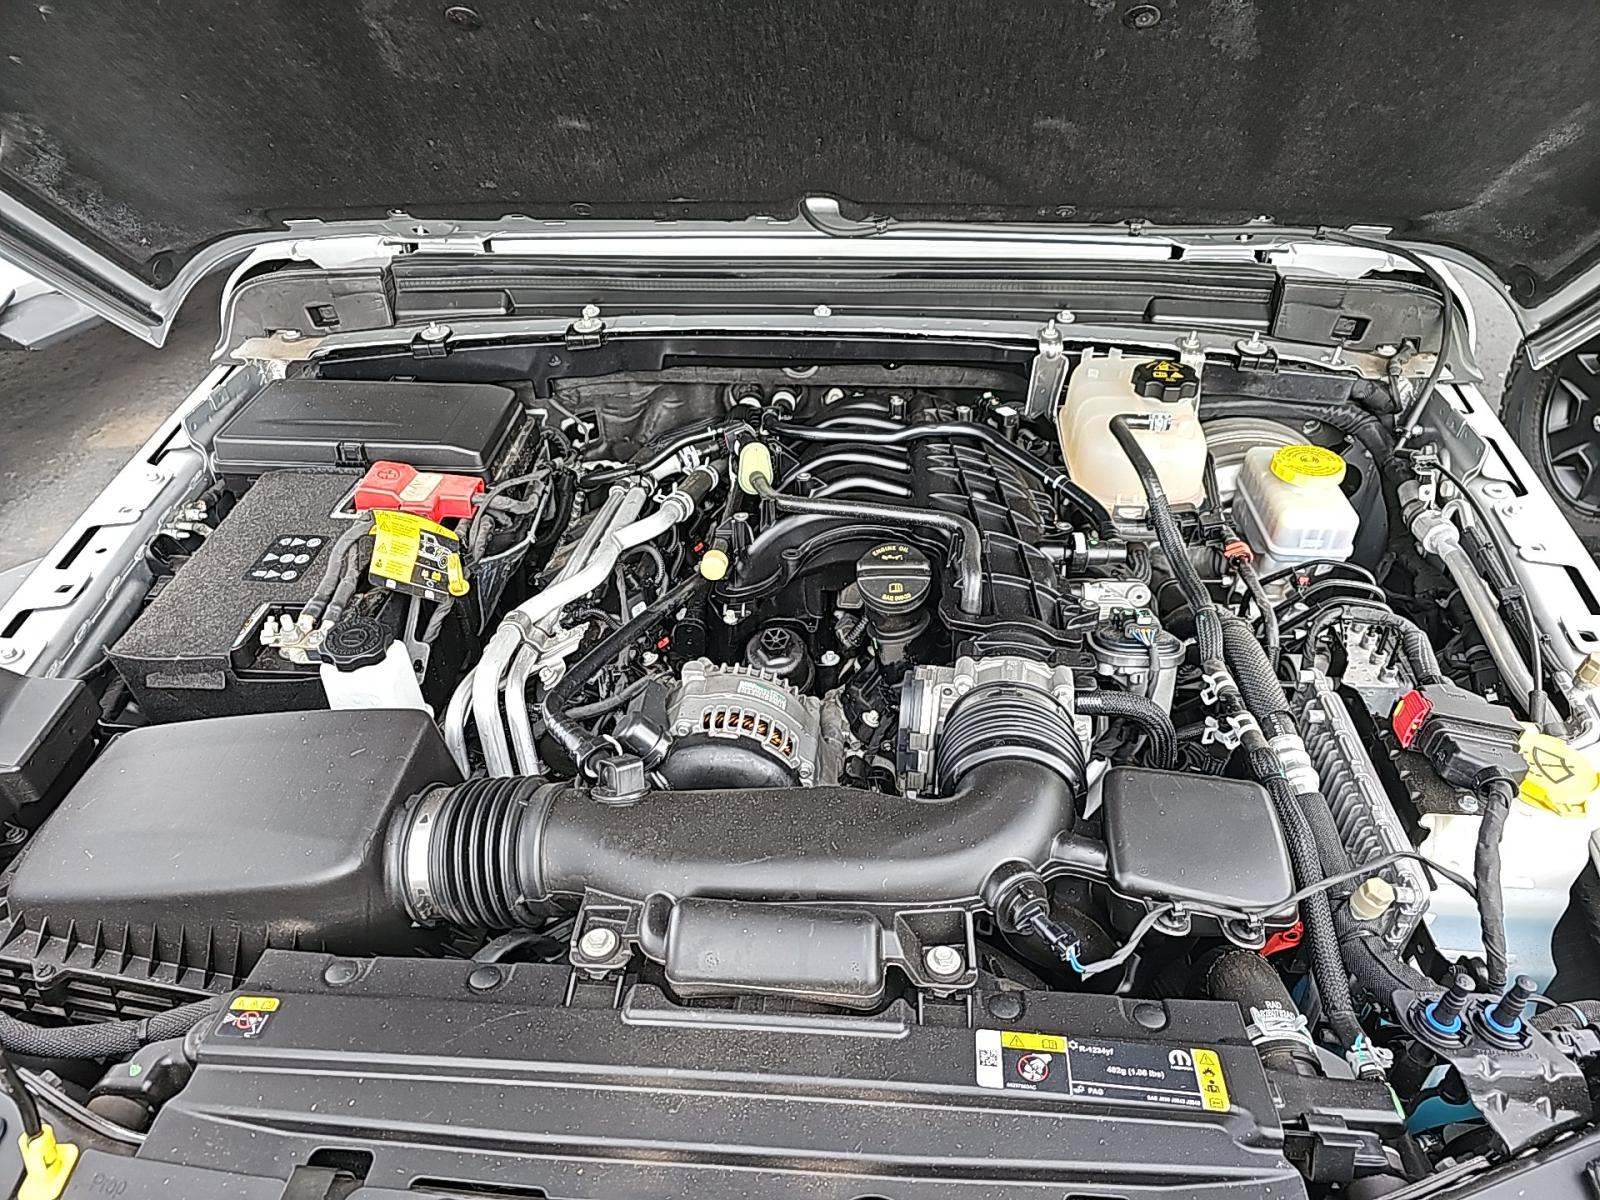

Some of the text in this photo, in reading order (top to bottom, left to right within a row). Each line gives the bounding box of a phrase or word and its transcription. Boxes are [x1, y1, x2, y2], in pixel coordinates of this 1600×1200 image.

[871, 545, 909, 556] ENGINE OIL
[89, 1172, 128, 1199] Prop
